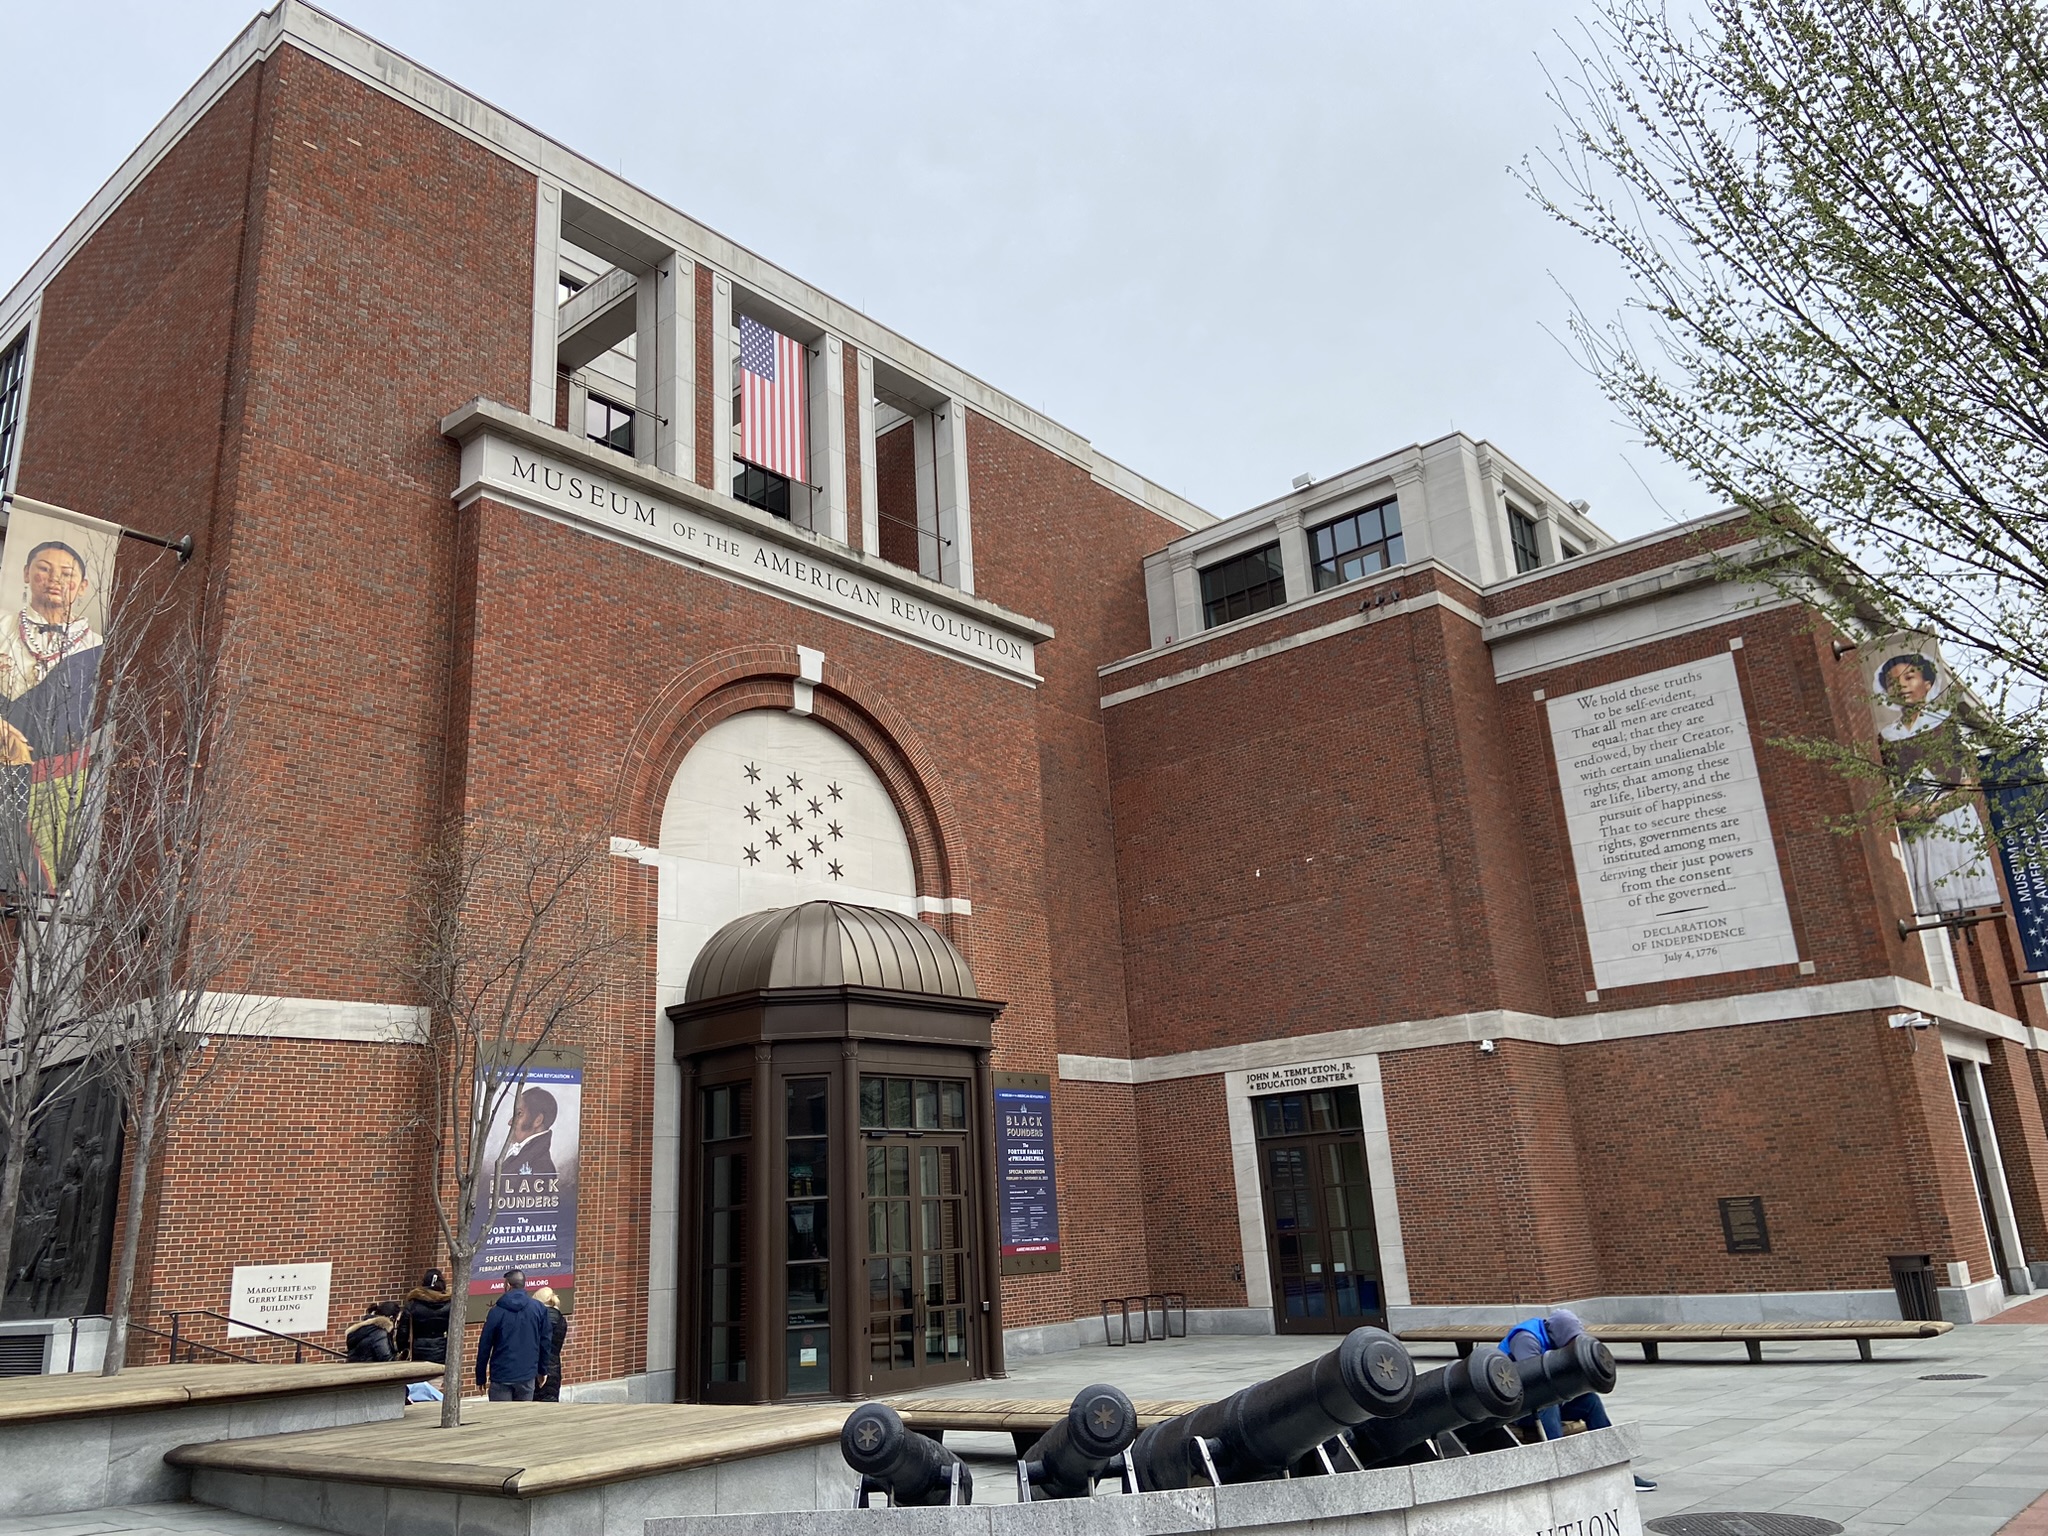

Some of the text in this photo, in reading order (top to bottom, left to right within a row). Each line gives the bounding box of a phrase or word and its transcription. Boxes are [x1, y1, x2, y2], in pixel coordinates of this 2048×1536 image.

[511, 455, 1022, 661] MUSEUM OF THE AMERICAN REVOLUTION
[1578, 672, 1702, 709] We hold these truths
[1594, 689, 1696, 720] to be self-evident,
[1572, 696, 1714, 739] That all men are created
[1592, 715, 1704, 750] equal; that they are
[1574, 725, 1734, 768] endowed, by their Creator,
[1580, 740, 1725, 781] with certain unalienable
[1583, 757, 1730, 797] rights; that among these
[1590, 771, 1730, 808] are life, liberty, and the
[1599, 792, 1726, 826] pursuit of happiness.
[1600, 804, 1727, 838] That to secure these
[1599, 818, 1740, 854] rights, governments are
[1603, 833, 1740, 864] instituted among men,
[1600, 848, 1753, 882] deriving their just powers
[1621, 866, 1732, 892] from the consent
[1628, 898, 1643, 907] of
[1645, 893, 1665, 904] the
[1643, 918, 1727, 938] DECLARATION
[1652, 927, 1745, 948] INDEPENDENCE
[1664, 948, 1717, 963] July 4, 1776
[1247, 1072, 1269, 1084] JOHN
[1284, 1064, 1339, 1077] TEMPLETON,
[1256, 1073, 1346, 1090] EDUCATION CENTER
[1006, 1116, 1042, 1126] BLACK
[1007, 1128, 1043, 1137] FOUNDERS
[495, 1234, 556, 1243] PHILADELPHIA
[486, 1252, 556, 1263] SPECIAL EXHIBITION
[247, 1286, 301, 1294] MARGUERITE
[260, 1304, 300, 1312] BUILDING
